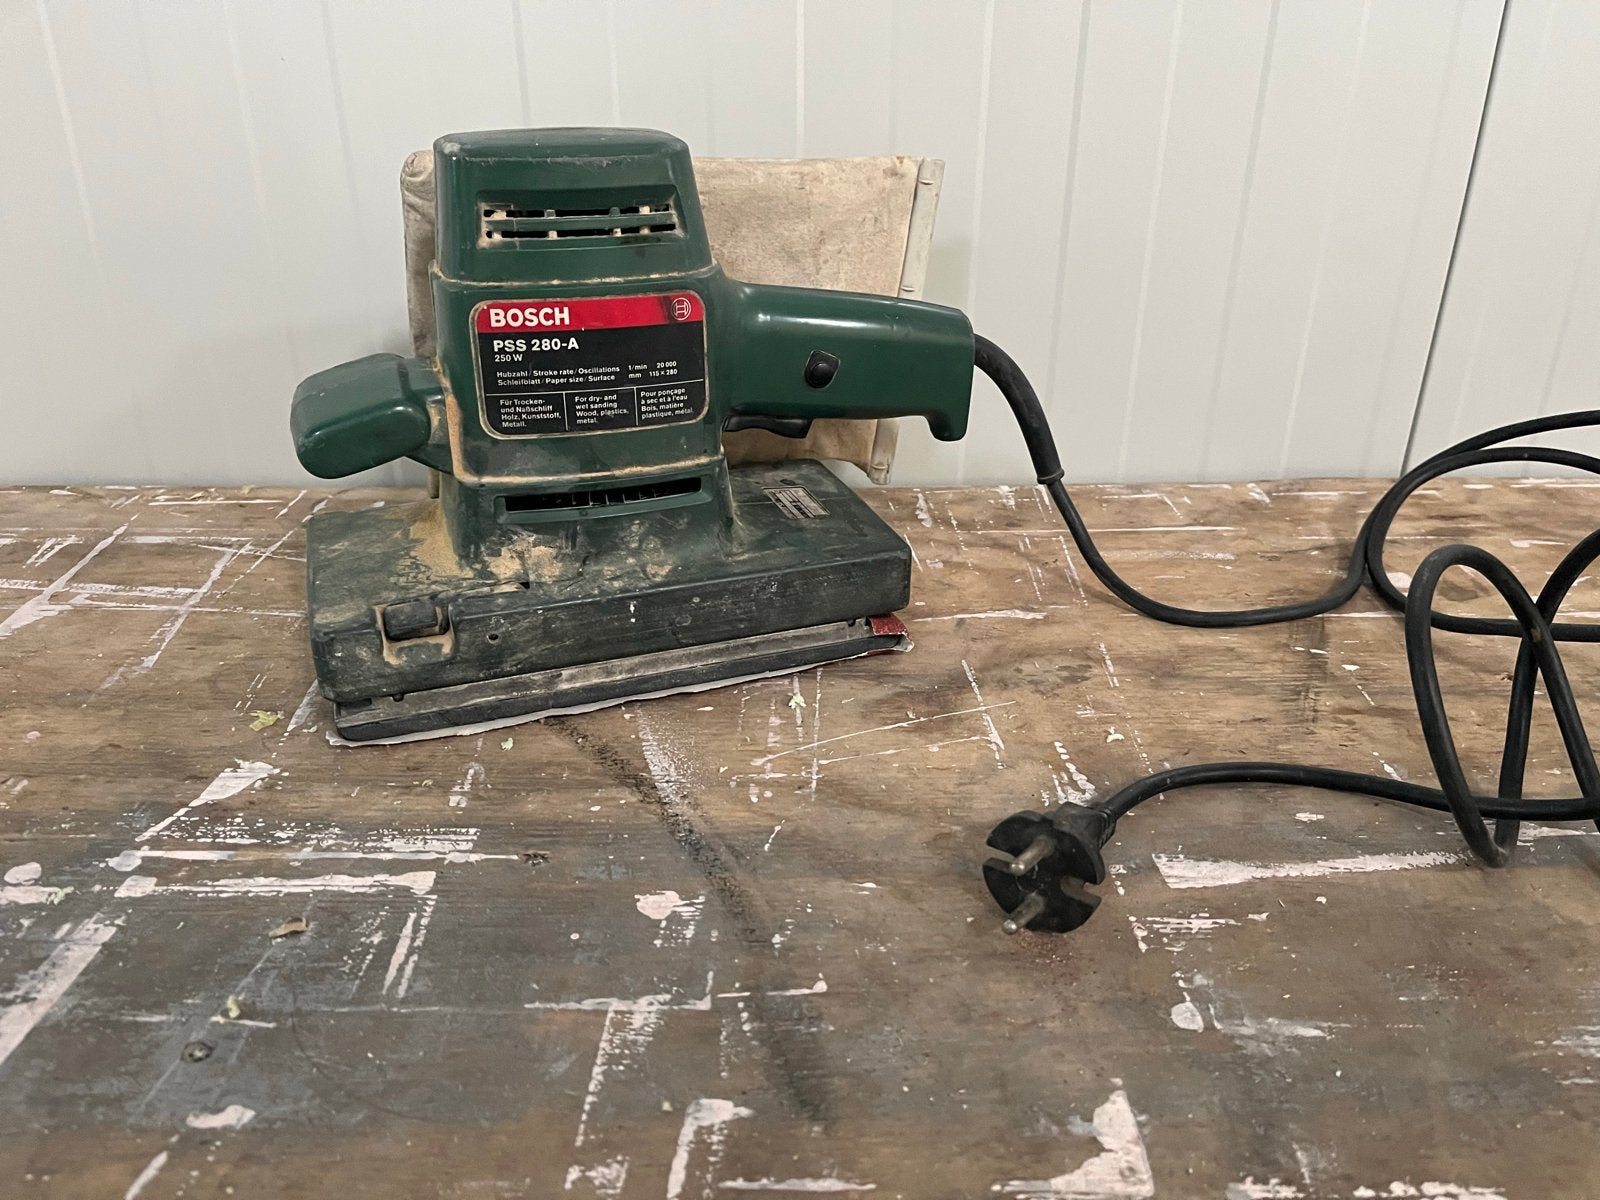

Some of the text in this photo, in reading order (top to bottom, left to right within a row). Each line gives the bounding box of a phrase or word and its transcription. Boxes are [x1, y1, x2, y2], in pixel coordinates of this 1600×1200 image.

[490, 306, 570, 327] BOSCH
[493, 337, 579, 352] PSS 280-A
[578, 366, 620, 374] Oscillations
[642, 410, 674, 419] plastique,
